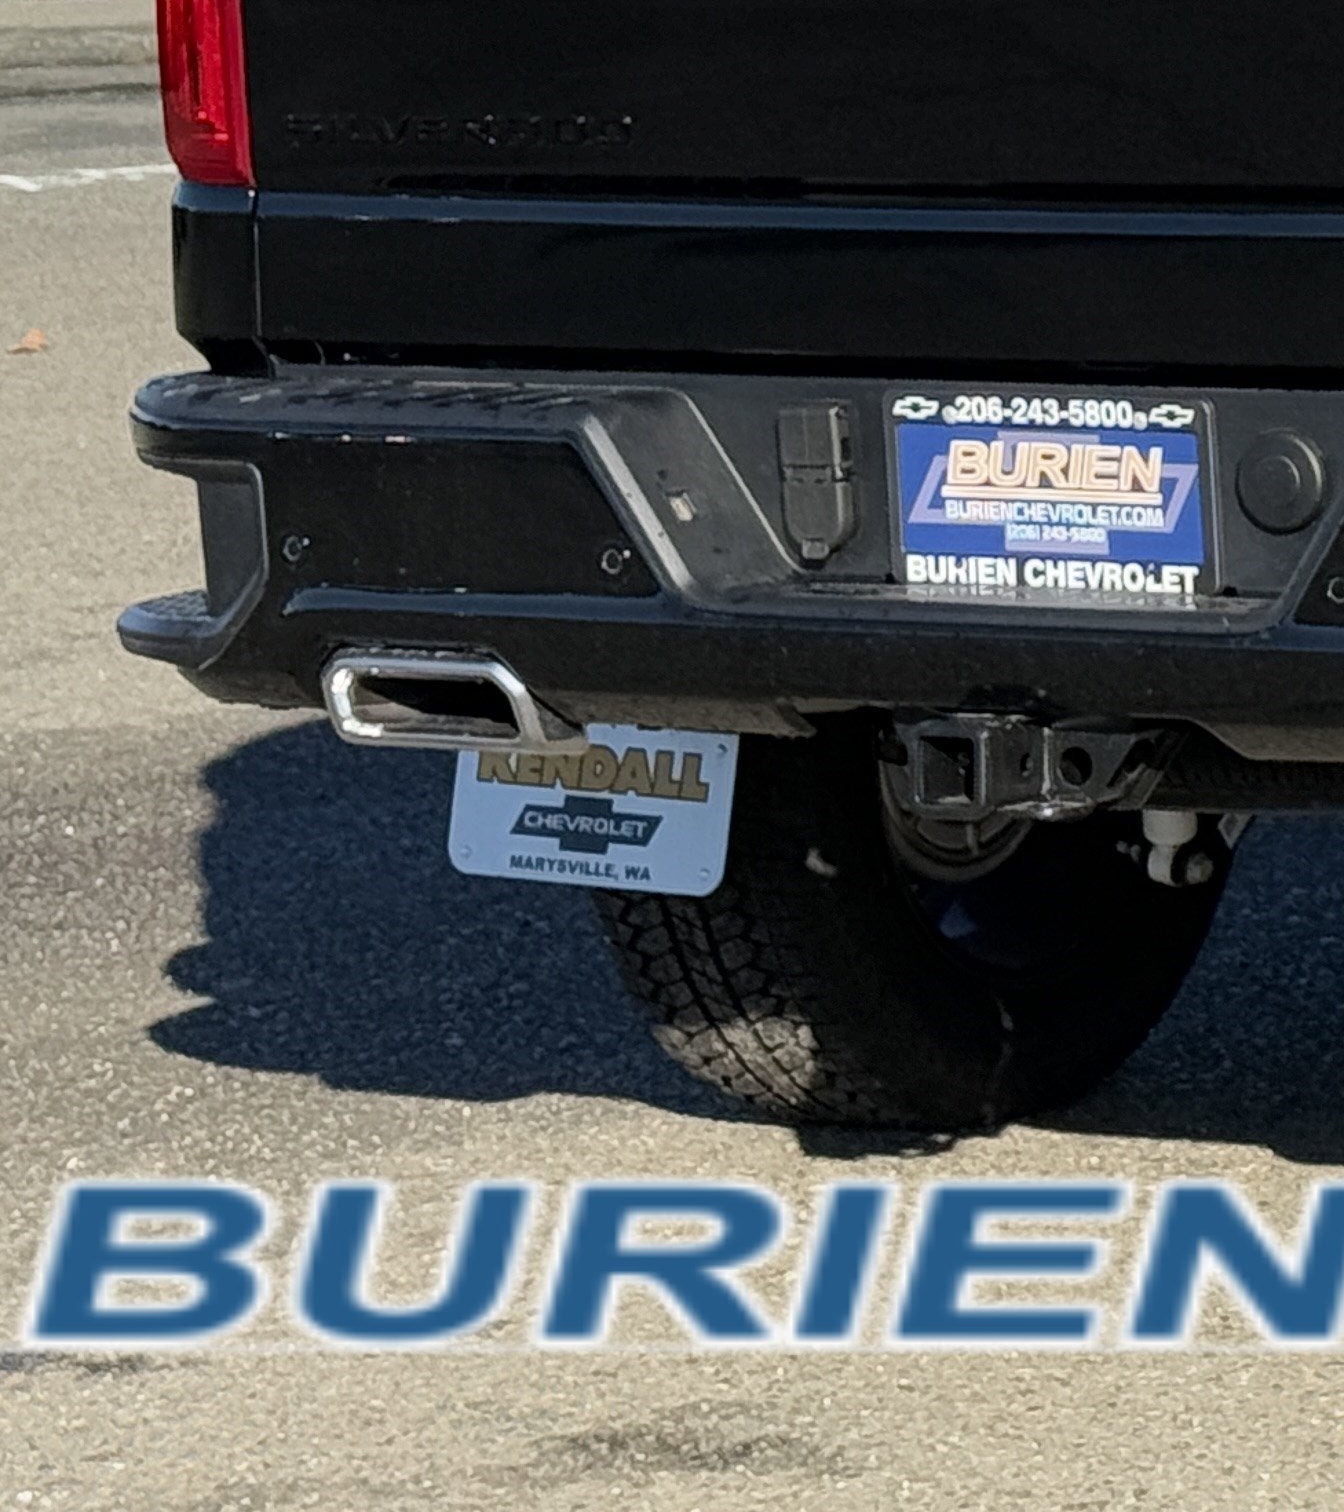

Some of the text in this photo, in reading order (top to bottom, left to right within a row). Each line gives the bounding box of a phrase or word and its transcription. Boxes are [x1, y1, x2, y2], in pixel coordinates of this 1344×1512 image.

[954, 394, 1133, 428] 206-243-5800
[946, 440, 1164, 493] BURIEN
[945, 500, 1165, 528] BURIENCHEVROLET.COM
[906, 553, 1200, 594] BURIEN CHEVROLET
[477, 744, 710, 803] KENDALL
[523, 810, 649, 838] CHEVROLET
[509, 854, 651, 881] MARYSVILLE, WA
